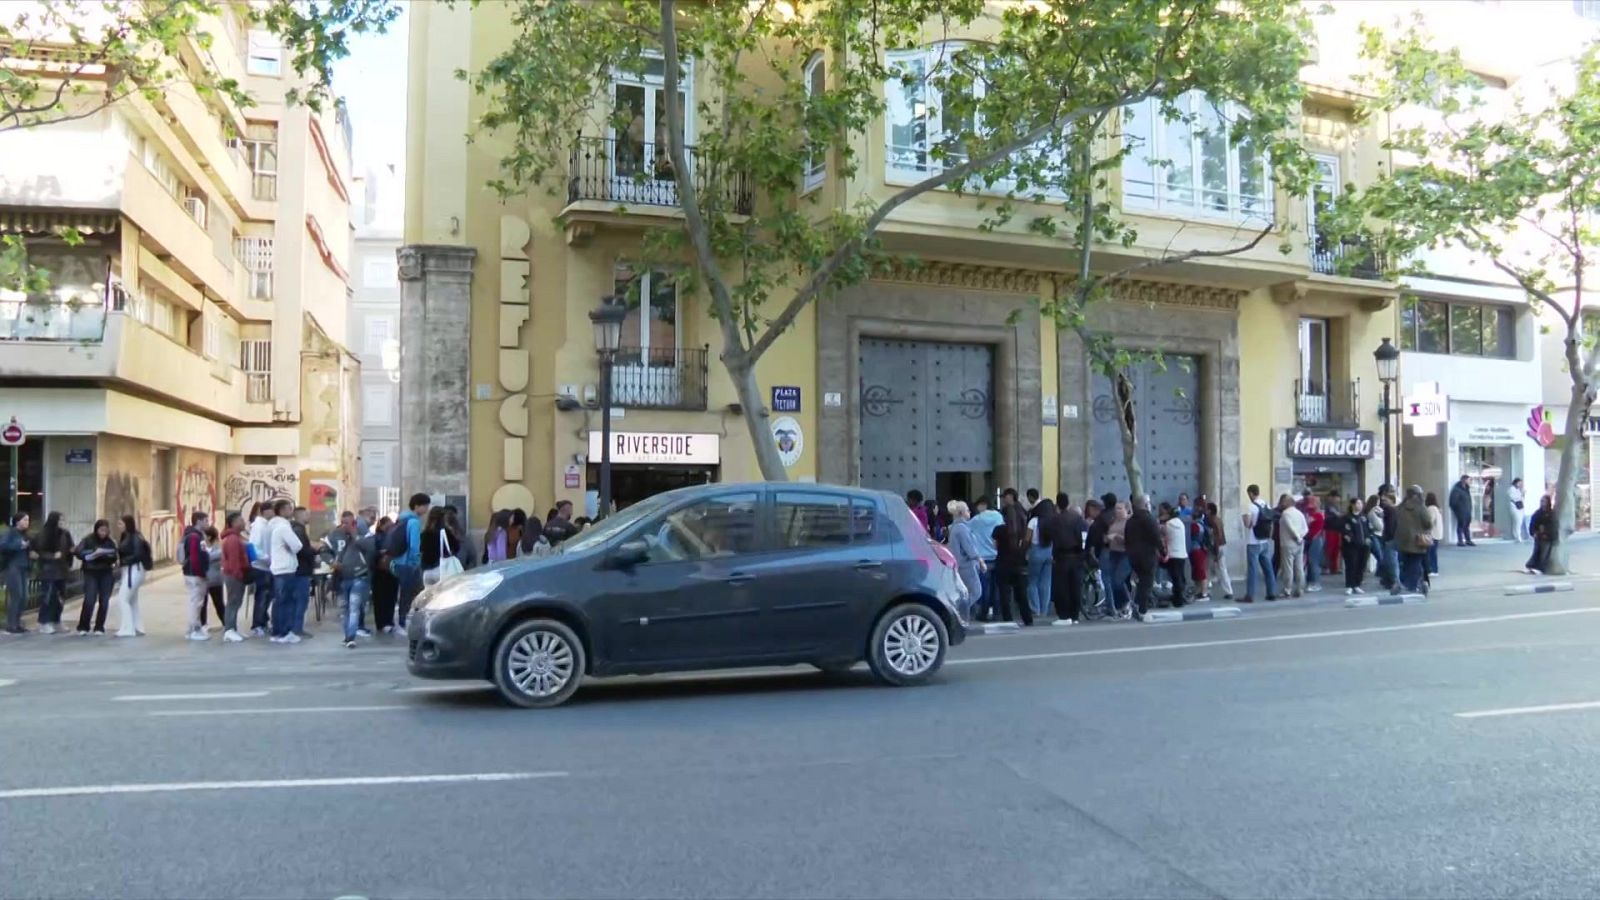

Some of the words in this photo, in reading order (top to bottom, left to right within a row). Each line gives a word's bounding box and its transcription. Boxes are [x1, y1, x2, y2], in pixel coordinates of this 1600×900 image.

[774, 388, 797, 397] PLAZA
[616, 434, 693, 456] RIVERSIDE
[1293, 430, 1371, 456] farmacia
